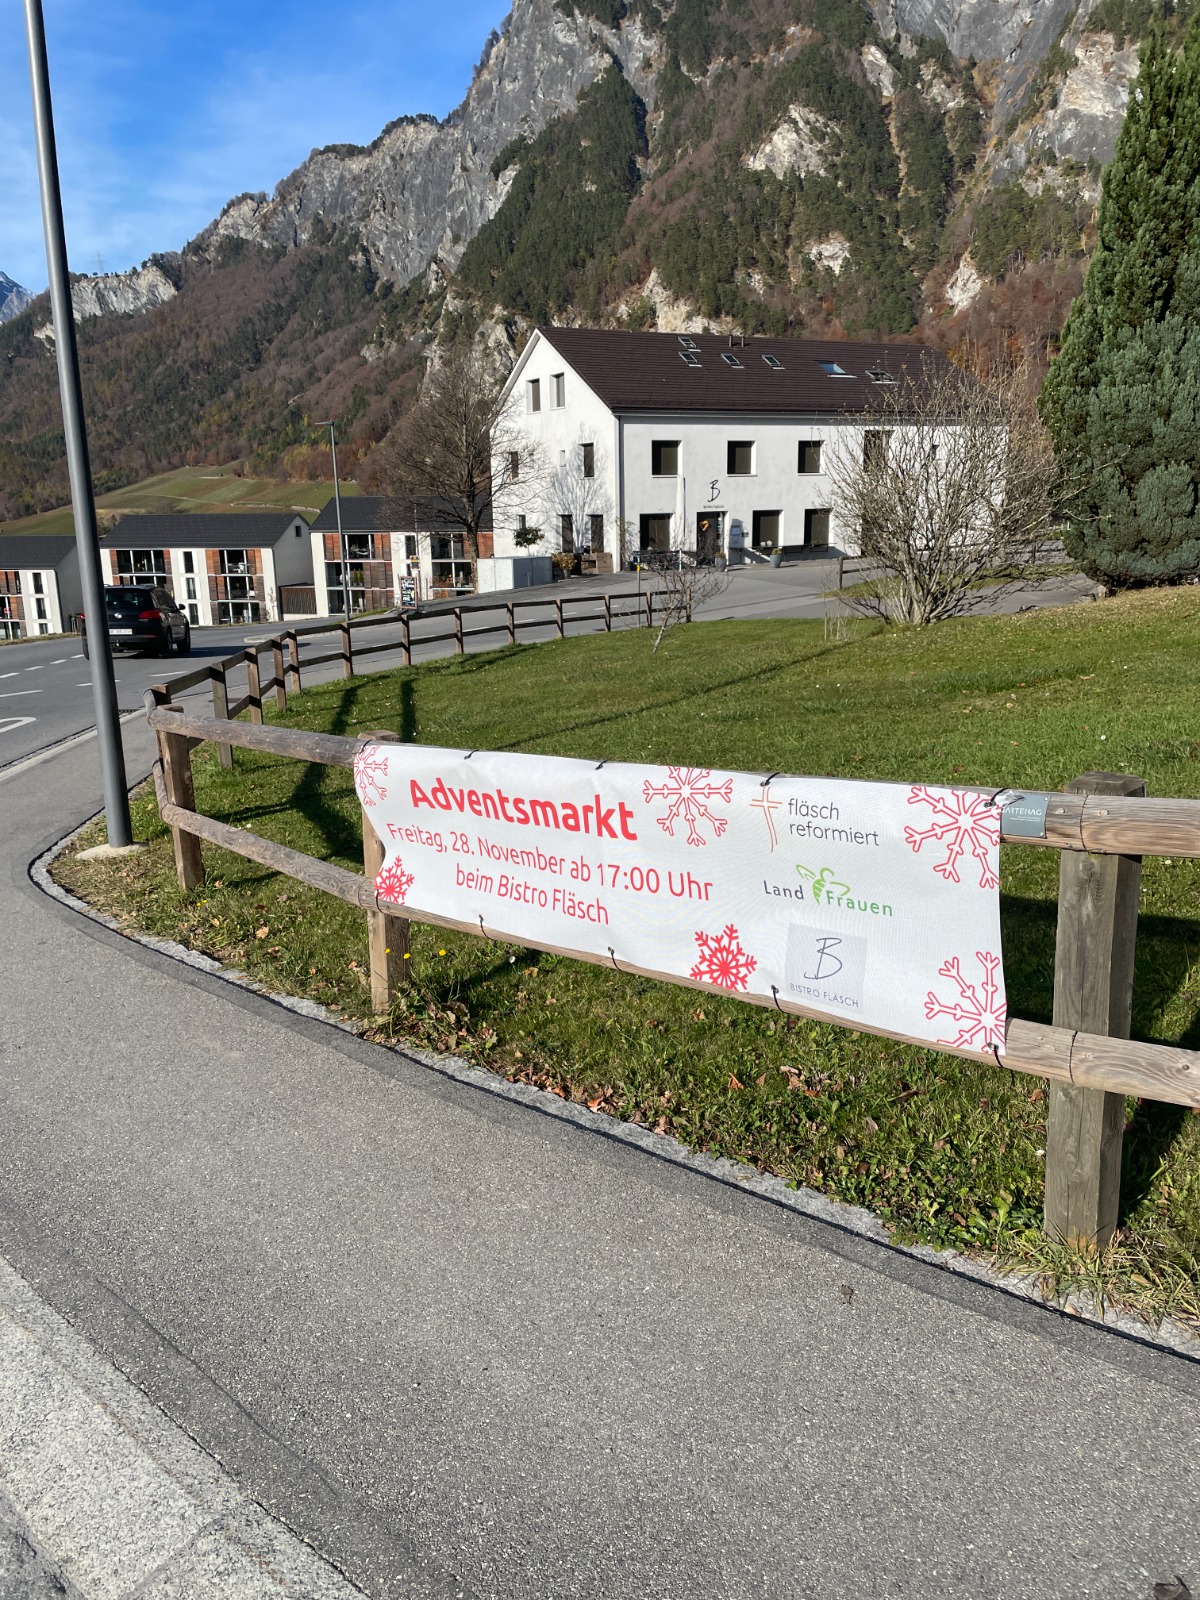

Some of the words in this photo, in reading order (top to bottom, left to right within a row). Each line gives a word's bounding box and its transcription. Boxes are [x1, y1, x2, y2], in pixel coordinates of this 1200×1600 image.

[410, 777, 638, 841] Adventsmarkt
[787, 797, 839, 821] fläsch
[789, 820, 880, 847] reformiert
[386, 823, 448, 854] Freitag,
[449, 831, 474, 856] 28.
[478, 837, 565, 876] November
[570, 855, 591, 883] ab
[597, 862, 660, 894] 17:00
[668, 870, 714, 902] Uhr
[456, 863, 494, 891] beim
[497, 875, 547, 908] Bistro
[552, 889, 609, 925] Fläsch
[763, 880, 805, 901] Land
[826, 889, 894, 918] Frauen
[803, 937, 843, 981] B
[789, 982, 820, 998] BISTRO
